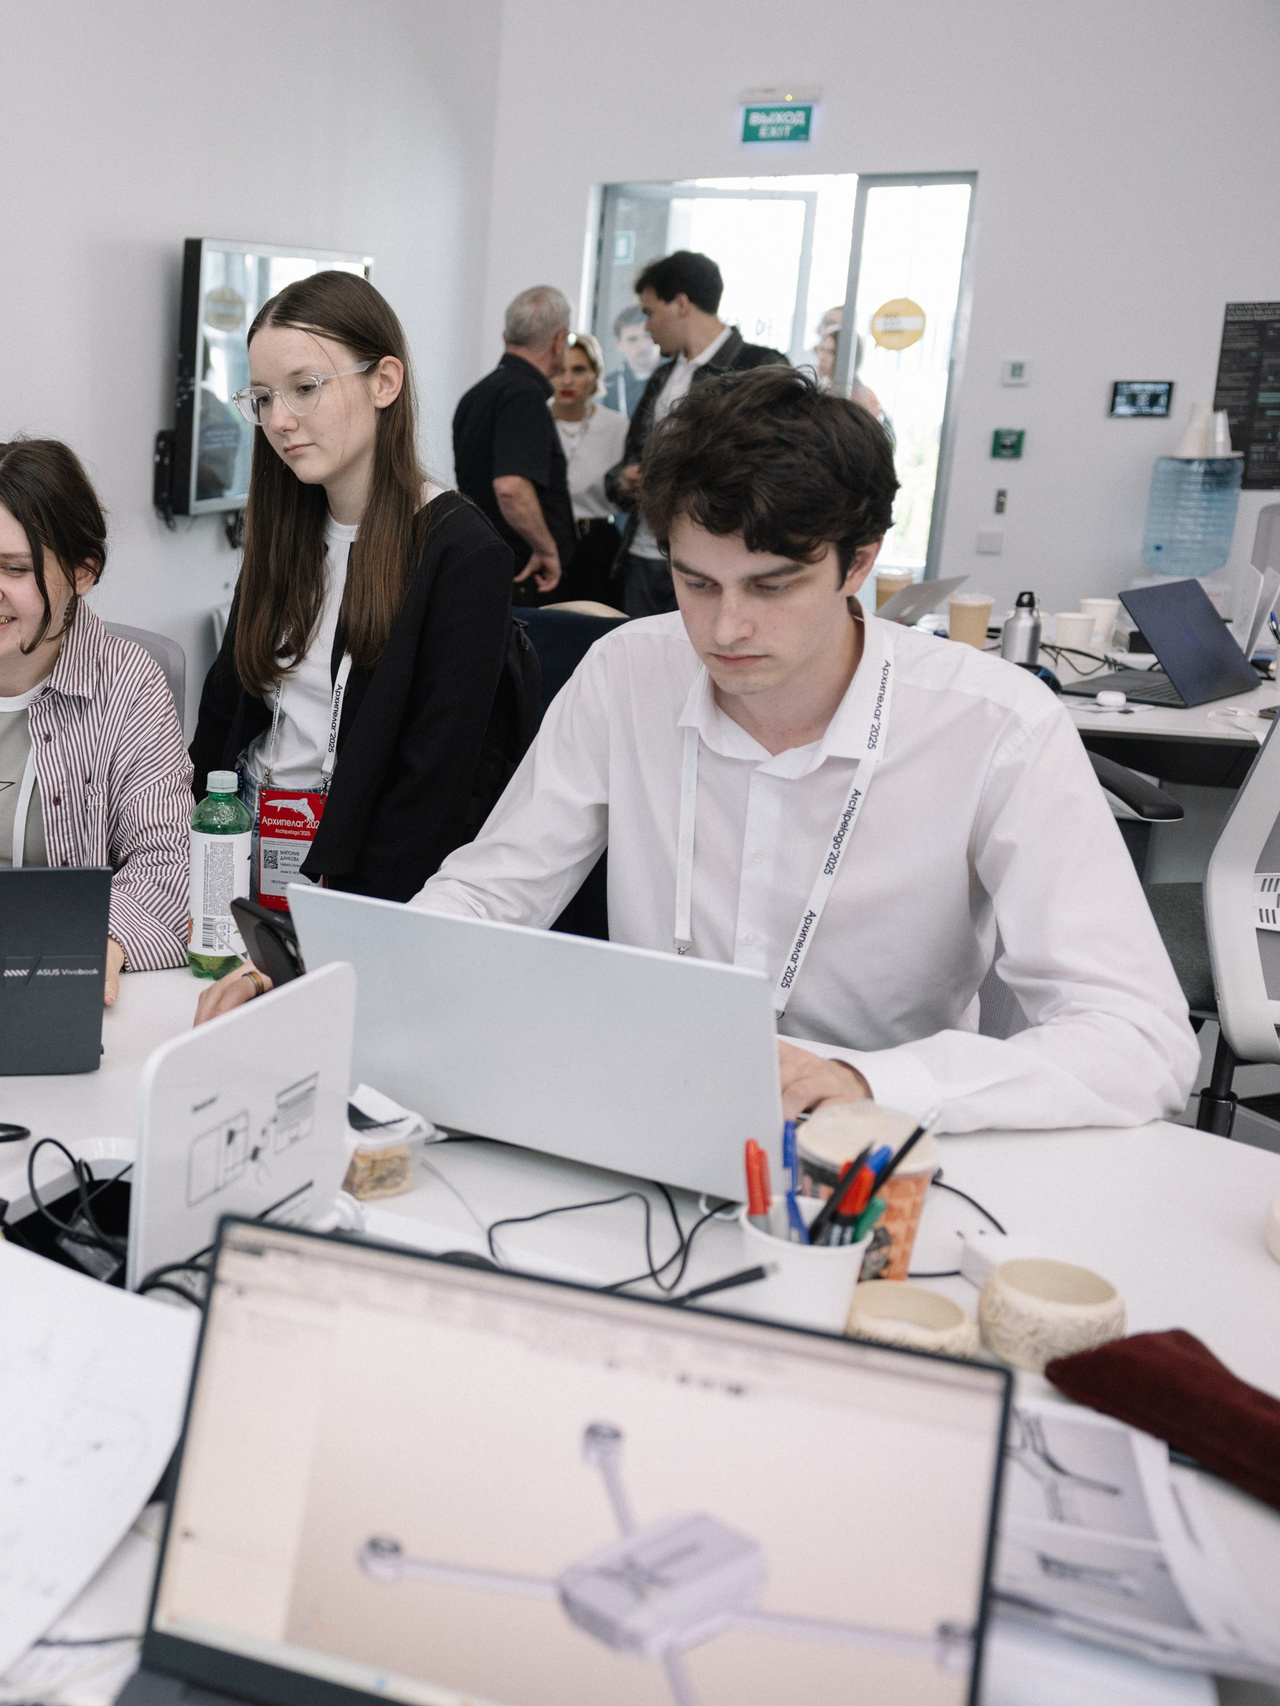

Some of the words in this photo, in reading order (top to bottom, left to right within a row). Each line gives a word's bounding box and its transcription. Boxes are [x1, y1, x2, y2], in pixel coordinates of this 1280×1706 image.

[759, 126, 792, 138] EXIT
[327, 684, 343, 754] Архипелаг'2025
[867, 659, 891, 750] Архипелаг'2025
[261, 816, 320, 829] Архипелаг'202
[823, 788, 862, 876] Archipelago'2025
[61, 968, 99, 976] Vivobook
[780, 909, 817, 990] Архипелаг'2025
